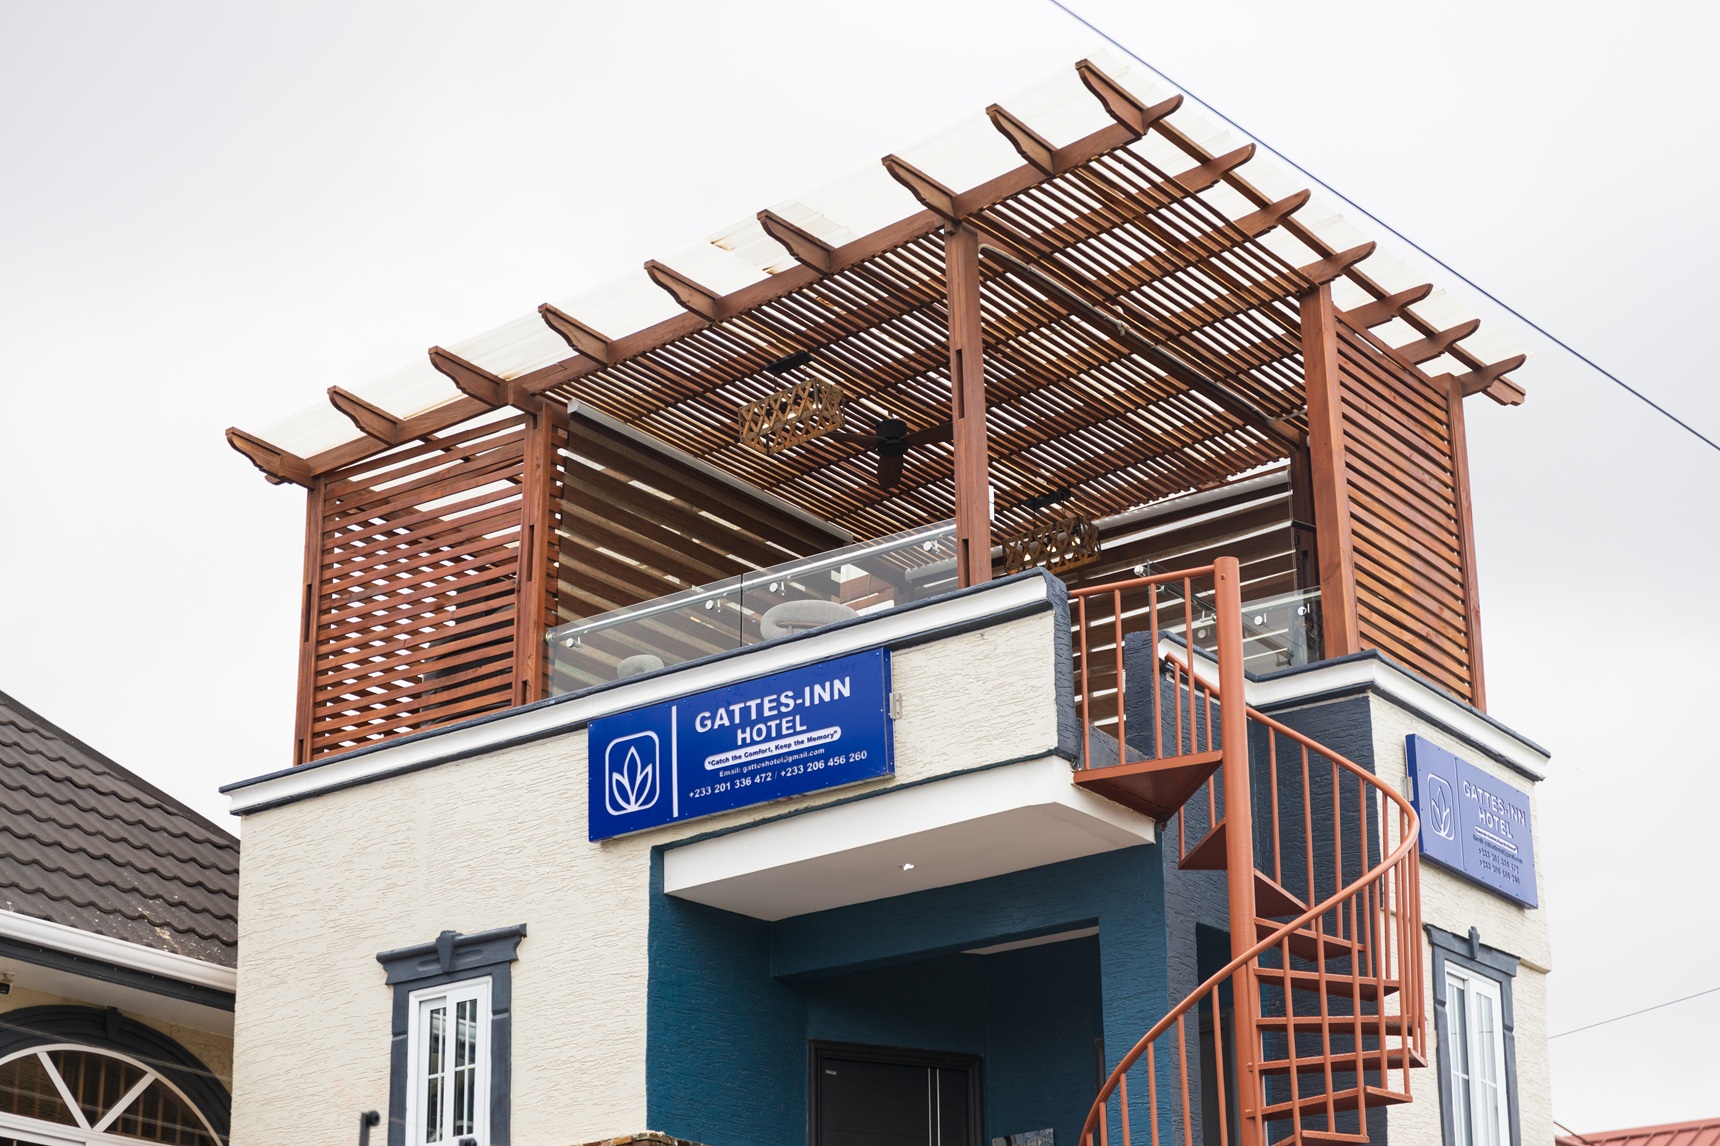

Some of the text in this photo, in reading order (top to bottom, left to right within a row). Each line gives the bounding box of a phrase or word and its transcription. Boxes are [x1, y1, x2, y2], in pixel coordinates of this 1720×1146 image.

[694, 676, 851, 733] GATTES-INN
[737, 714, 807, 745] HOTEL
[732, 753, 742, 762] the
[744, 747, 773, 758] Comfort,
[775, 740, 792, 751] Keep
[794, 738, 804, 746] the
[689, 787, 711, 798] +233
[714, 782, 730, 793] 201
[735, 776, 751, 788] 336
[754, 772, 772, 783] 472
[780, 765, 804, 777] +233
[807, 759, 824, 771] 206
[828, 755, 846, 767] 456
[849, 750, 867, 762] 260
[719, 768, 741, 777] Email:
[1463, 780, 1526, 827] GATTES-INN
[1479, 807, 1513, 839] HOTEL
